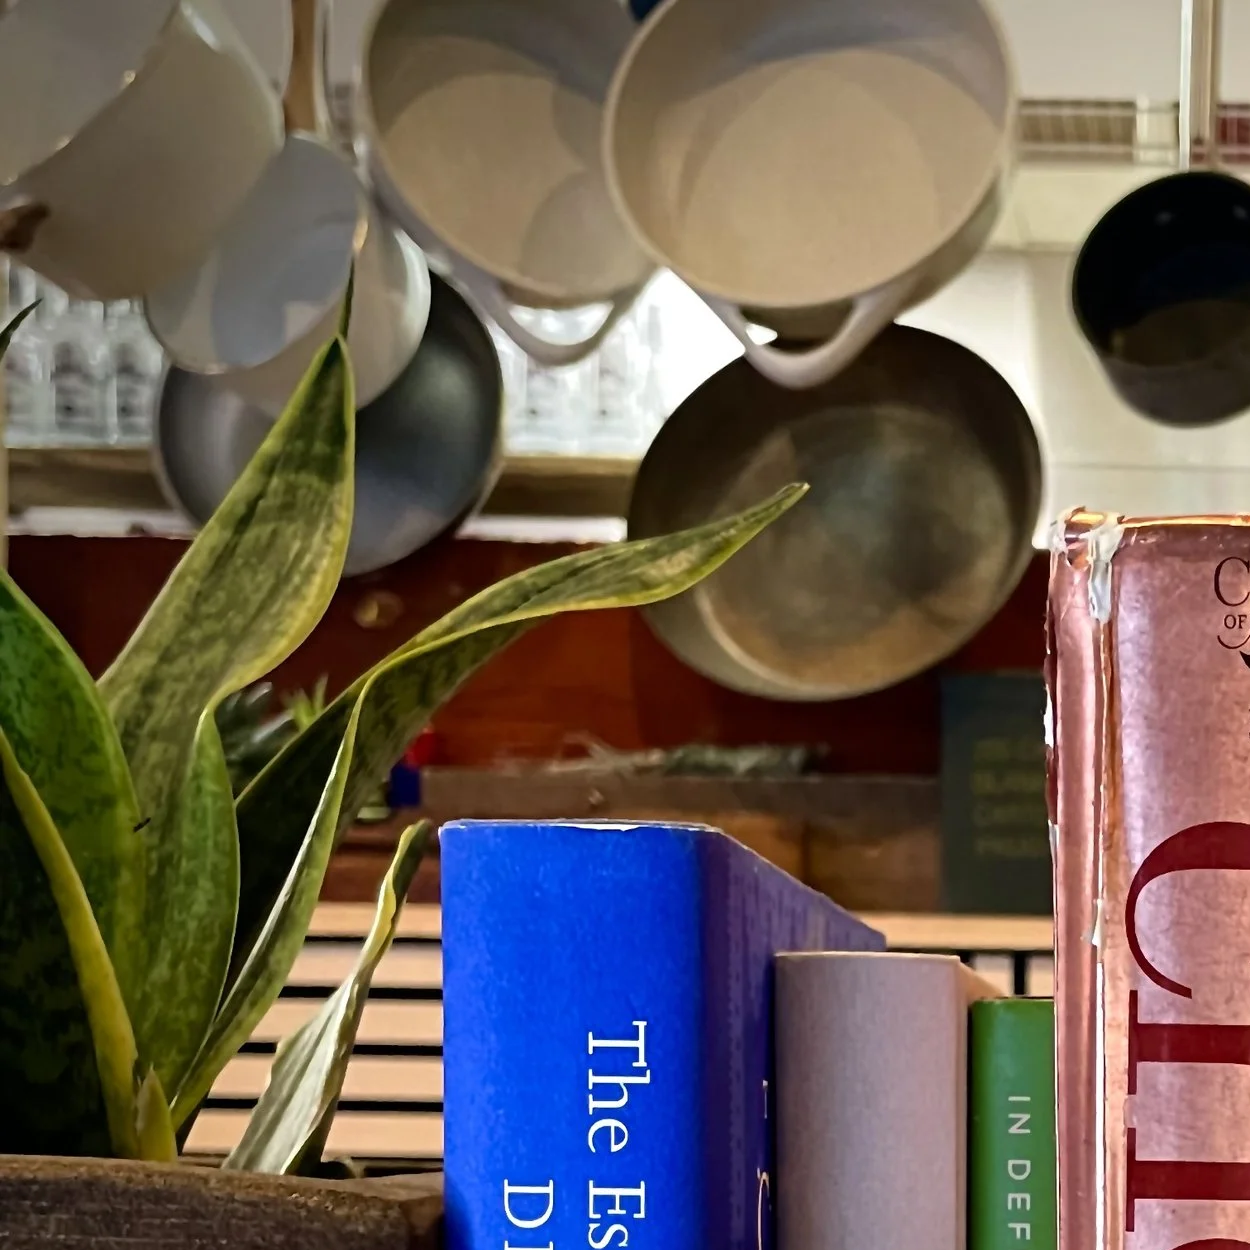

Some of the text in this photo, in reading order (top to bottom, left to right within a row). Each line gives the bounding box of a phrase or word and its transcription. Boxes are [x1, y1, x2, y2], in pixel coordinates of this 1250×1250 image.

[1224, 614, 1247, 629] OF
[587, 1020, 651, 1153] The
[1007, 1096, 1031, 1134] IN
